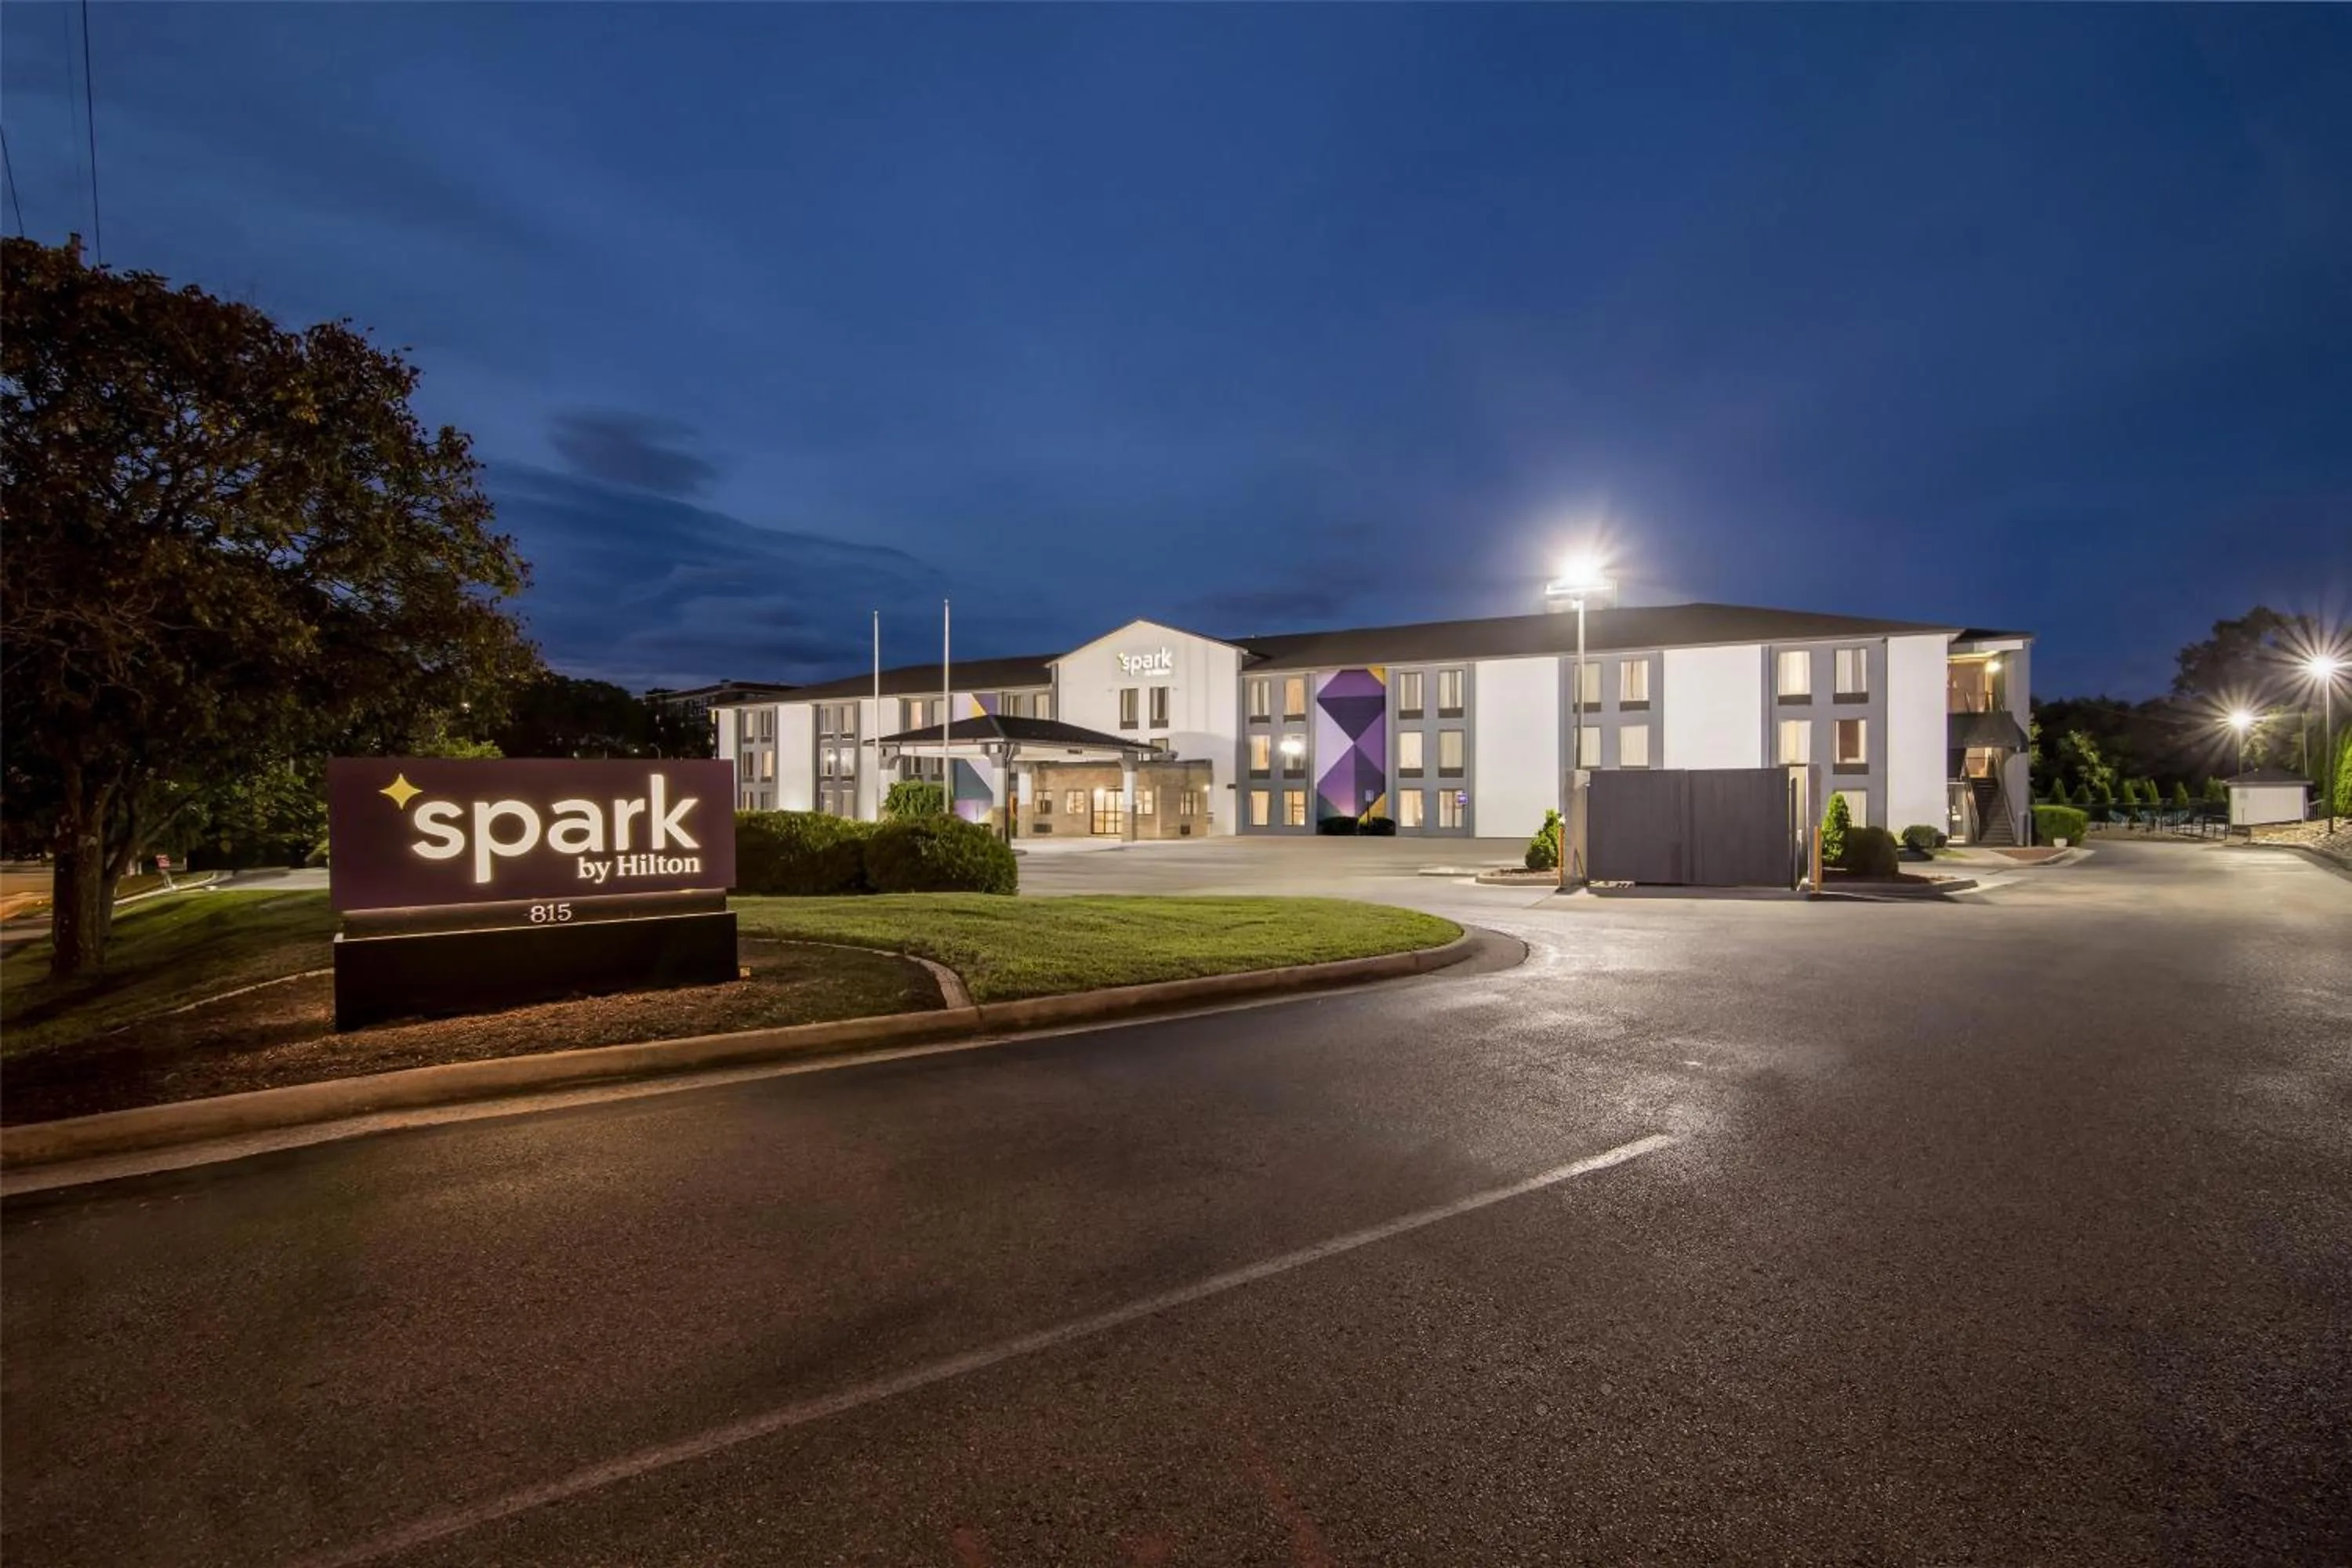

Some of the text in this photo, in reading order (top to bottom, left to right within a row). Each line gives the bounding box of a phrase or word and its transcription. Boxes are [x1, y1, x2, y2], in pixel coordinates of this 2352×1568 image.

[1121, 647, 1173, 676] spark
[412, 774, 701, 883] spark
[578, 855, 701, 884] by Hilton
[530, 904, 572, 924] 815
